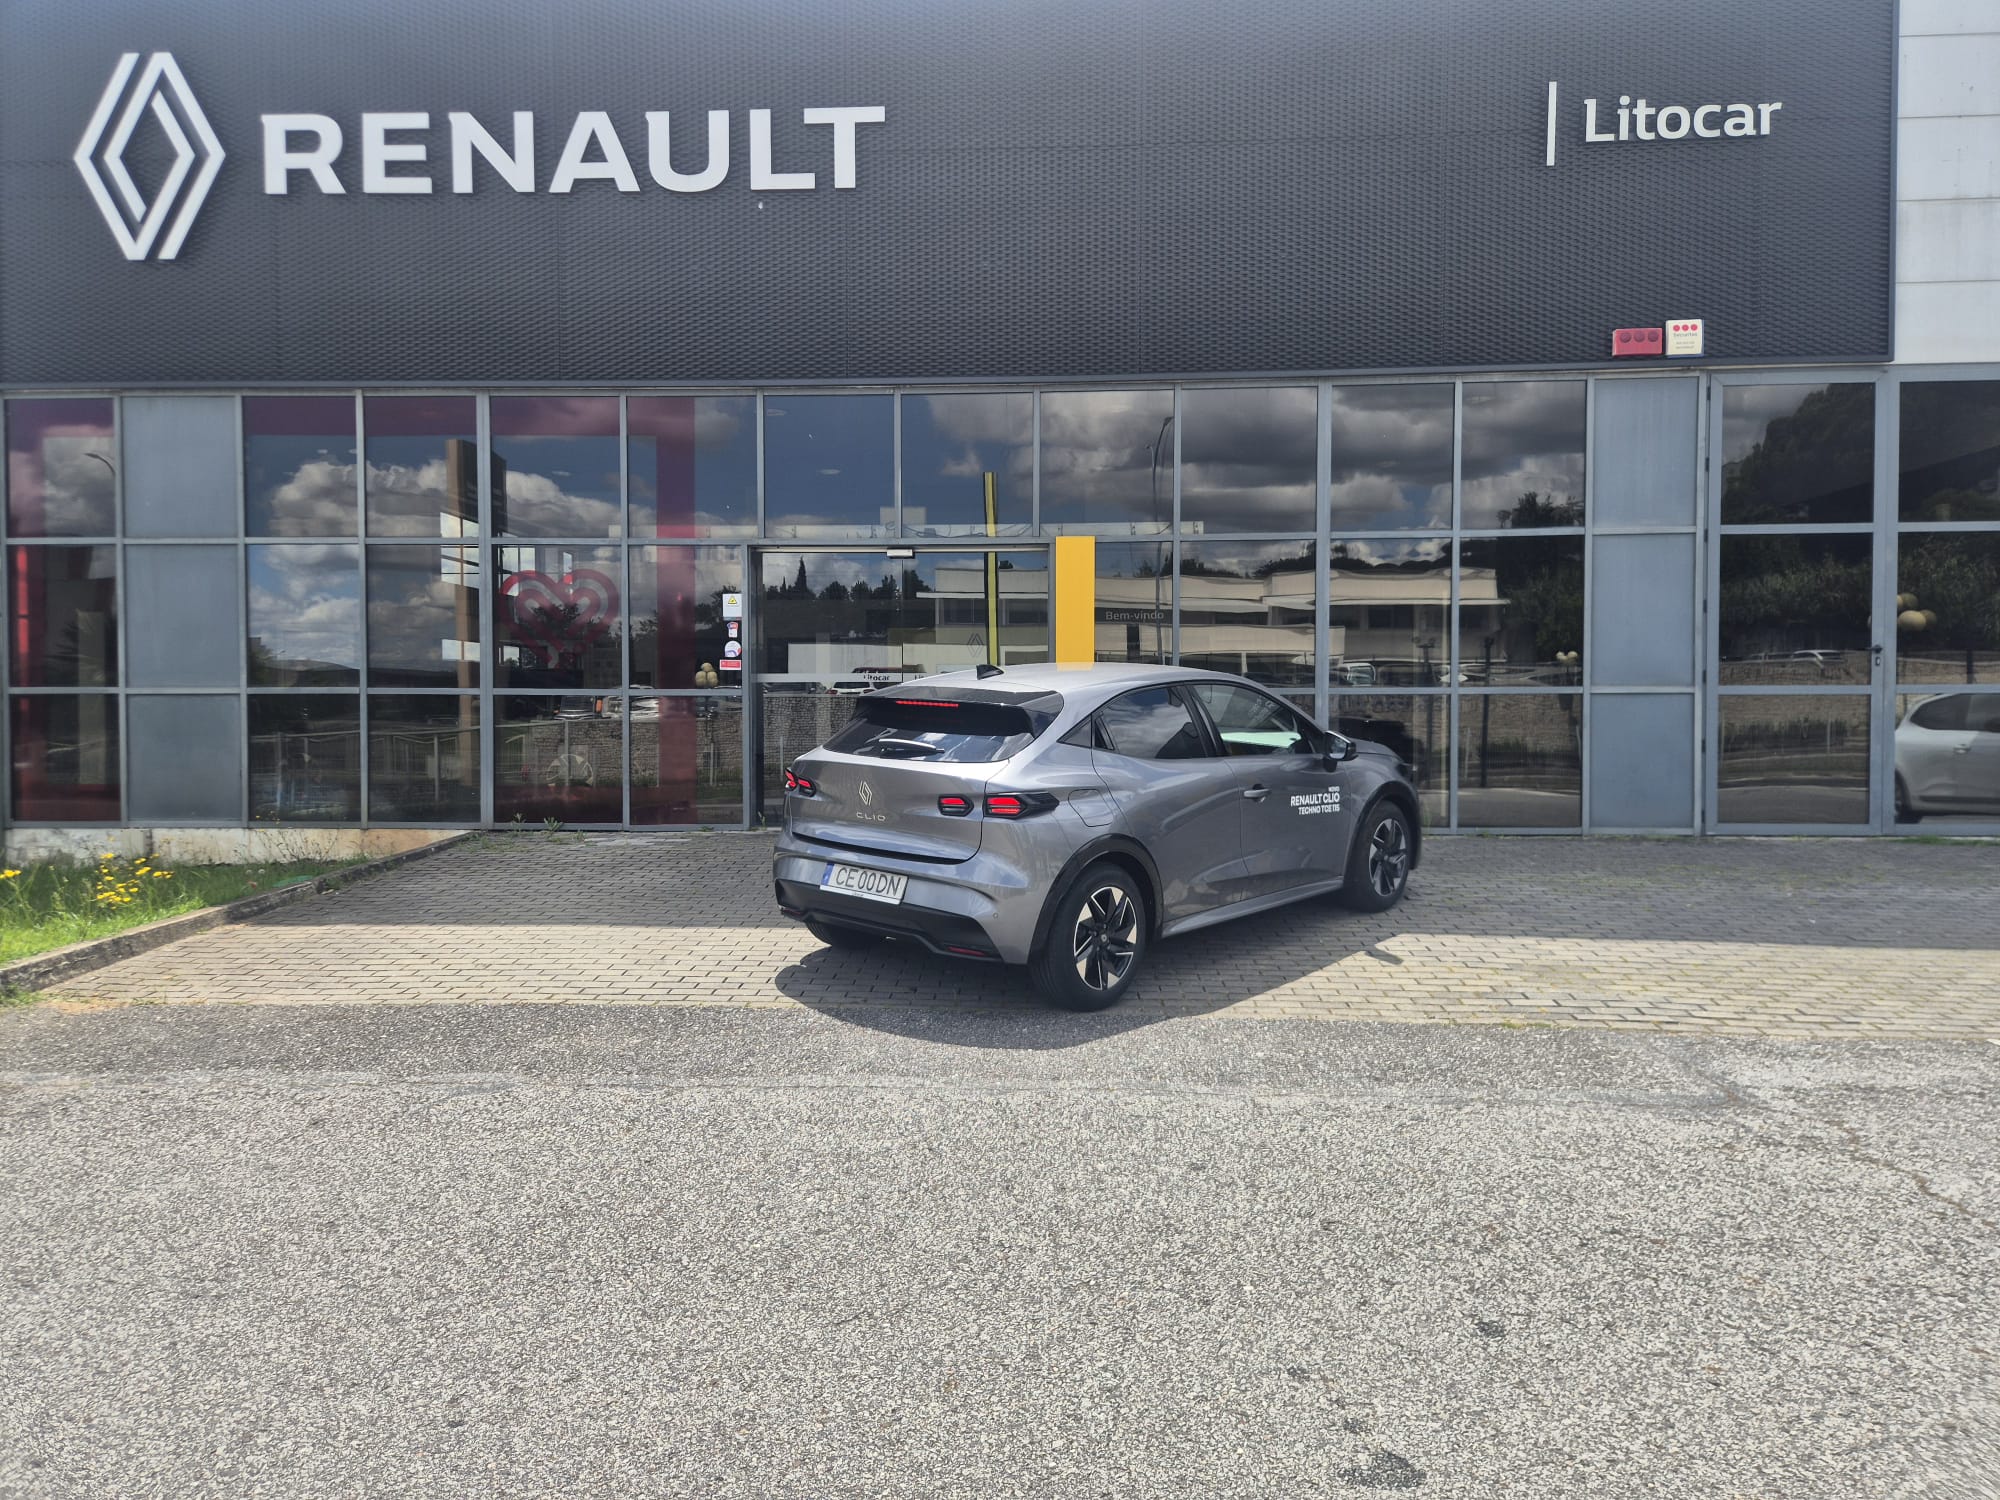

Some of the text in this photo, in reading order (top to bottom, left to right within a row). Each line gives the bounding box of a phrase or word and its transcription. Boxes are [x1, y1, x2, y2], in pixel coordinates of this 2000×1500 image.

[1583, 95, 1783, 143] Litocar
[260, 106, 886, 195] RENAULT
[1105, 610, 1165, 620] Bem-vindo
[1290, 792, 1340, 806] RENAULT CLIO
[856, 811, 886, 822] CLIO
[1298, 806, 1320, 815] TECHNO
